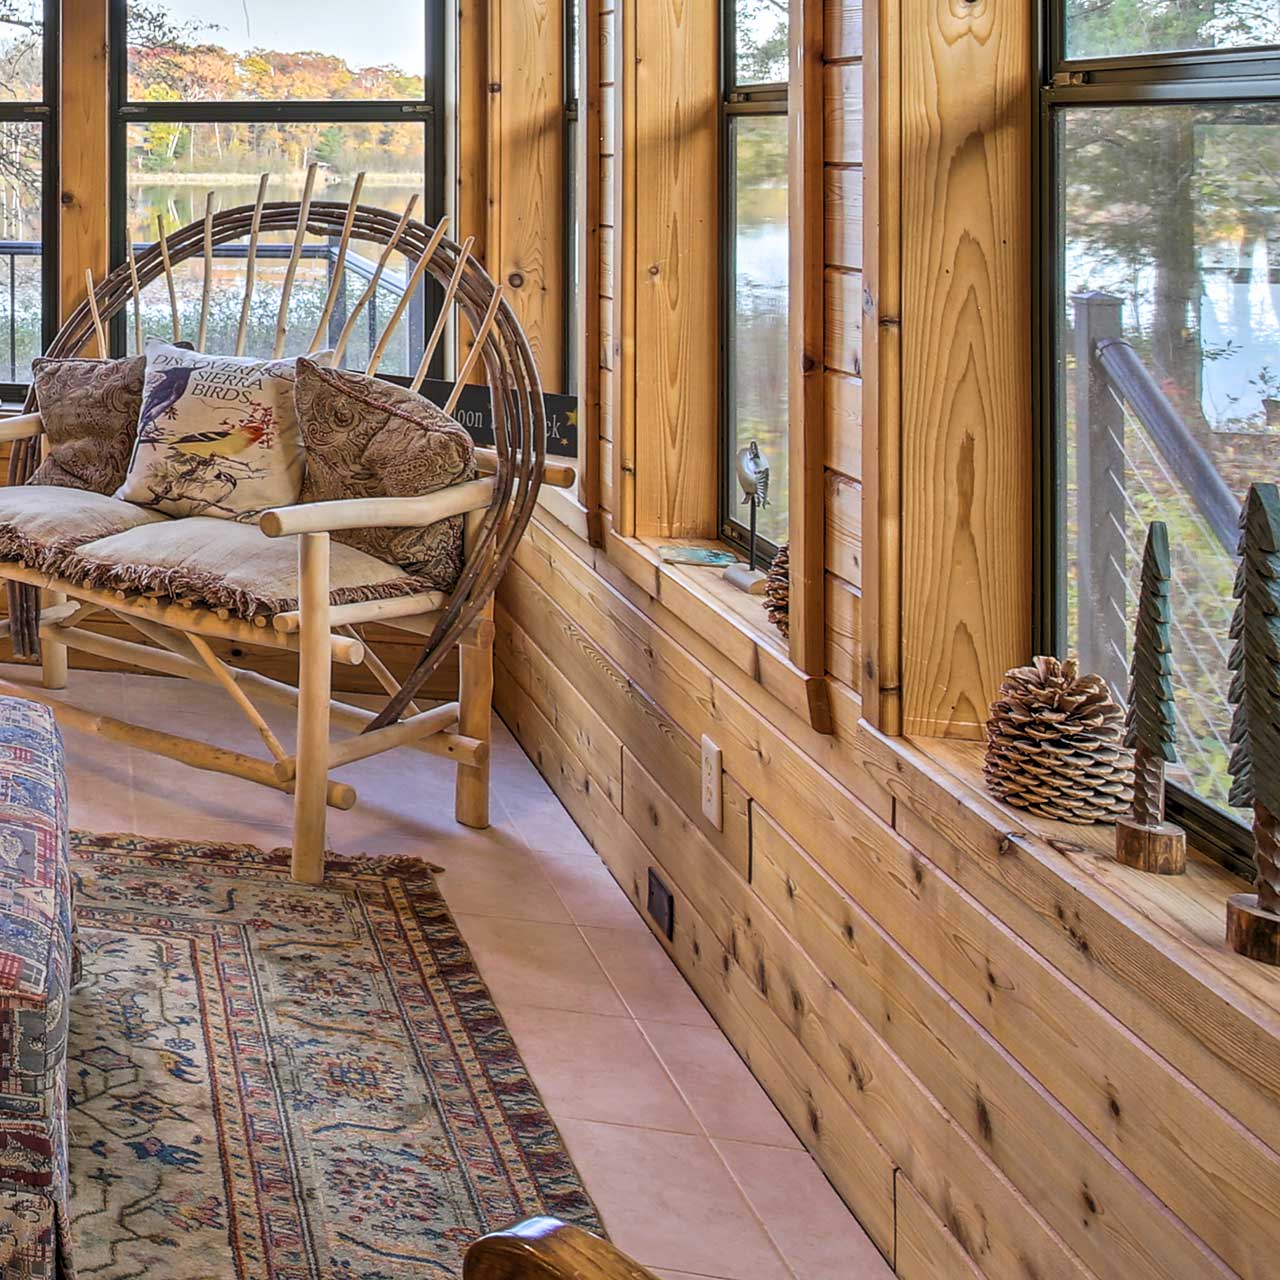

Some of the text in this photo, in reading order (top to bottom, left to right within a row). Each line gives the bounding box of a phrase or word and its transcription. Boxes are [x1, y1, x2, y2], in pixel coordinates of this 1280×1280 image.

[193, 370, 263, 391] SIERRA
[191, 383, 252, 404] BIRDS
[453, 405, 483, 428] oon
